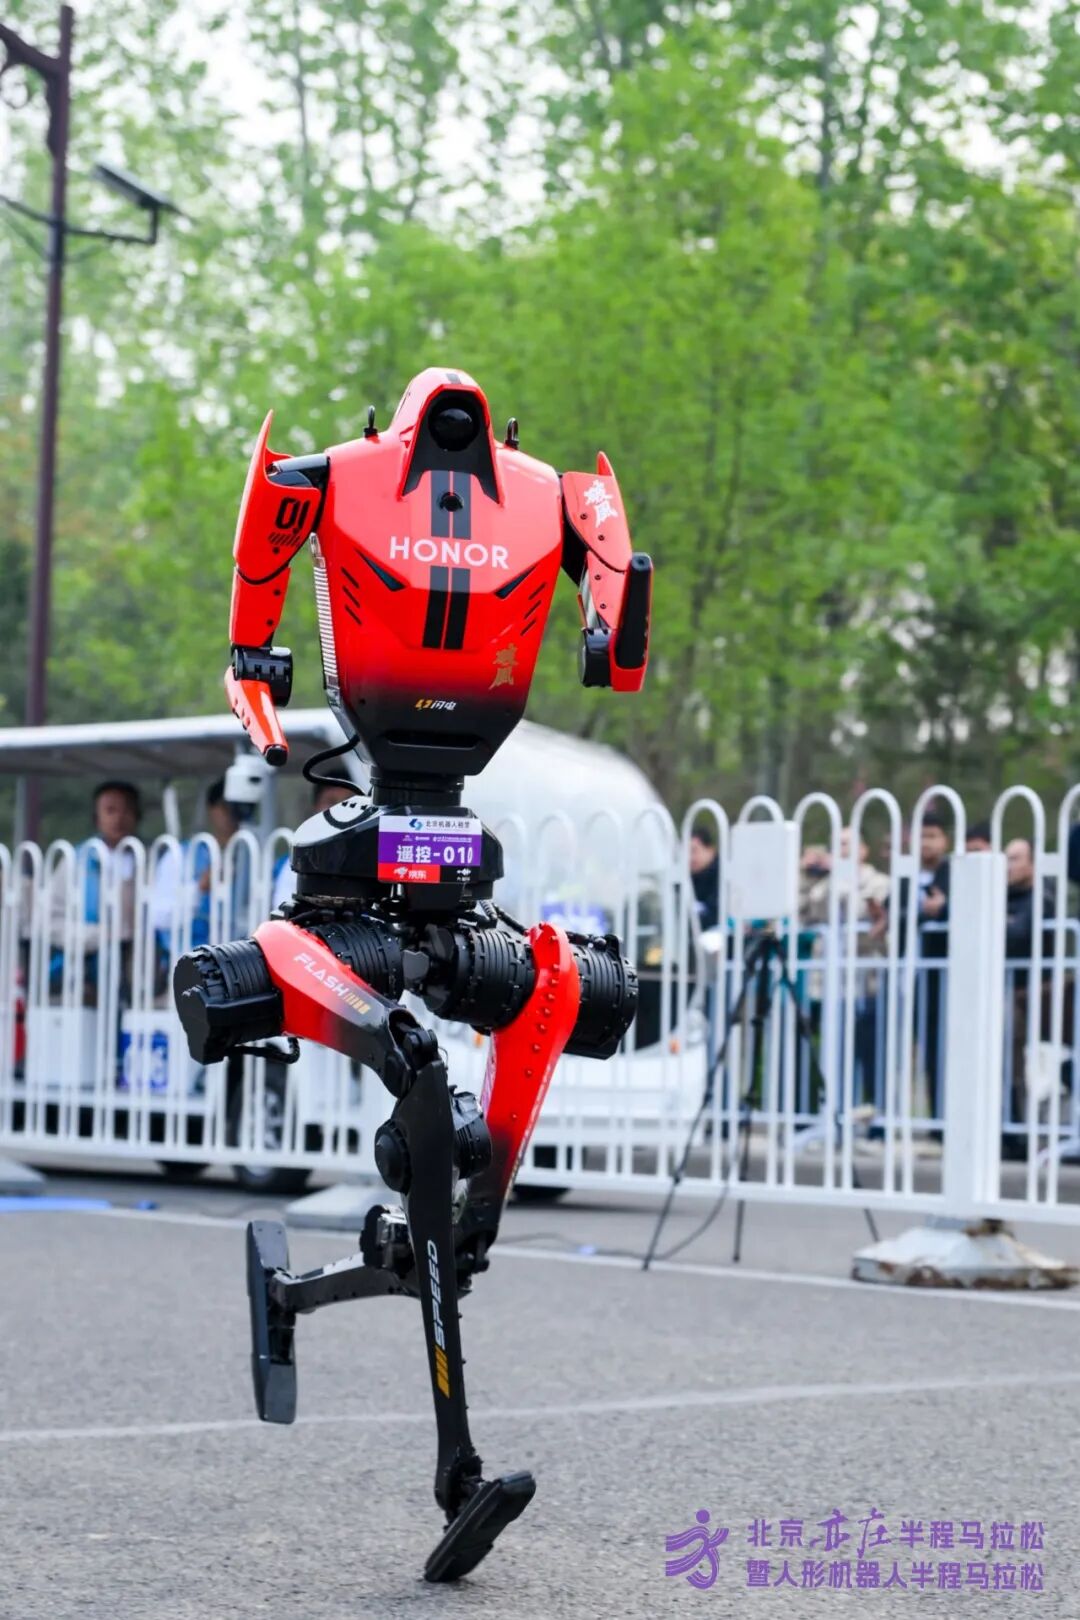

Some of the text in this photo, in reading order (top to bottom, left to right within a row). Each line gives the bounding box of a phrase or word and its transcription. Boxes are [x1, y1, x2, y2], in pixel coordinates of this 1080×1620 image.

[275, 496, 311, 530] 01
[389, 535, 509, 570] HONOR
[293, 952, 350, 997] FLASH
[427, 1239, 446, 1350] SPEED
